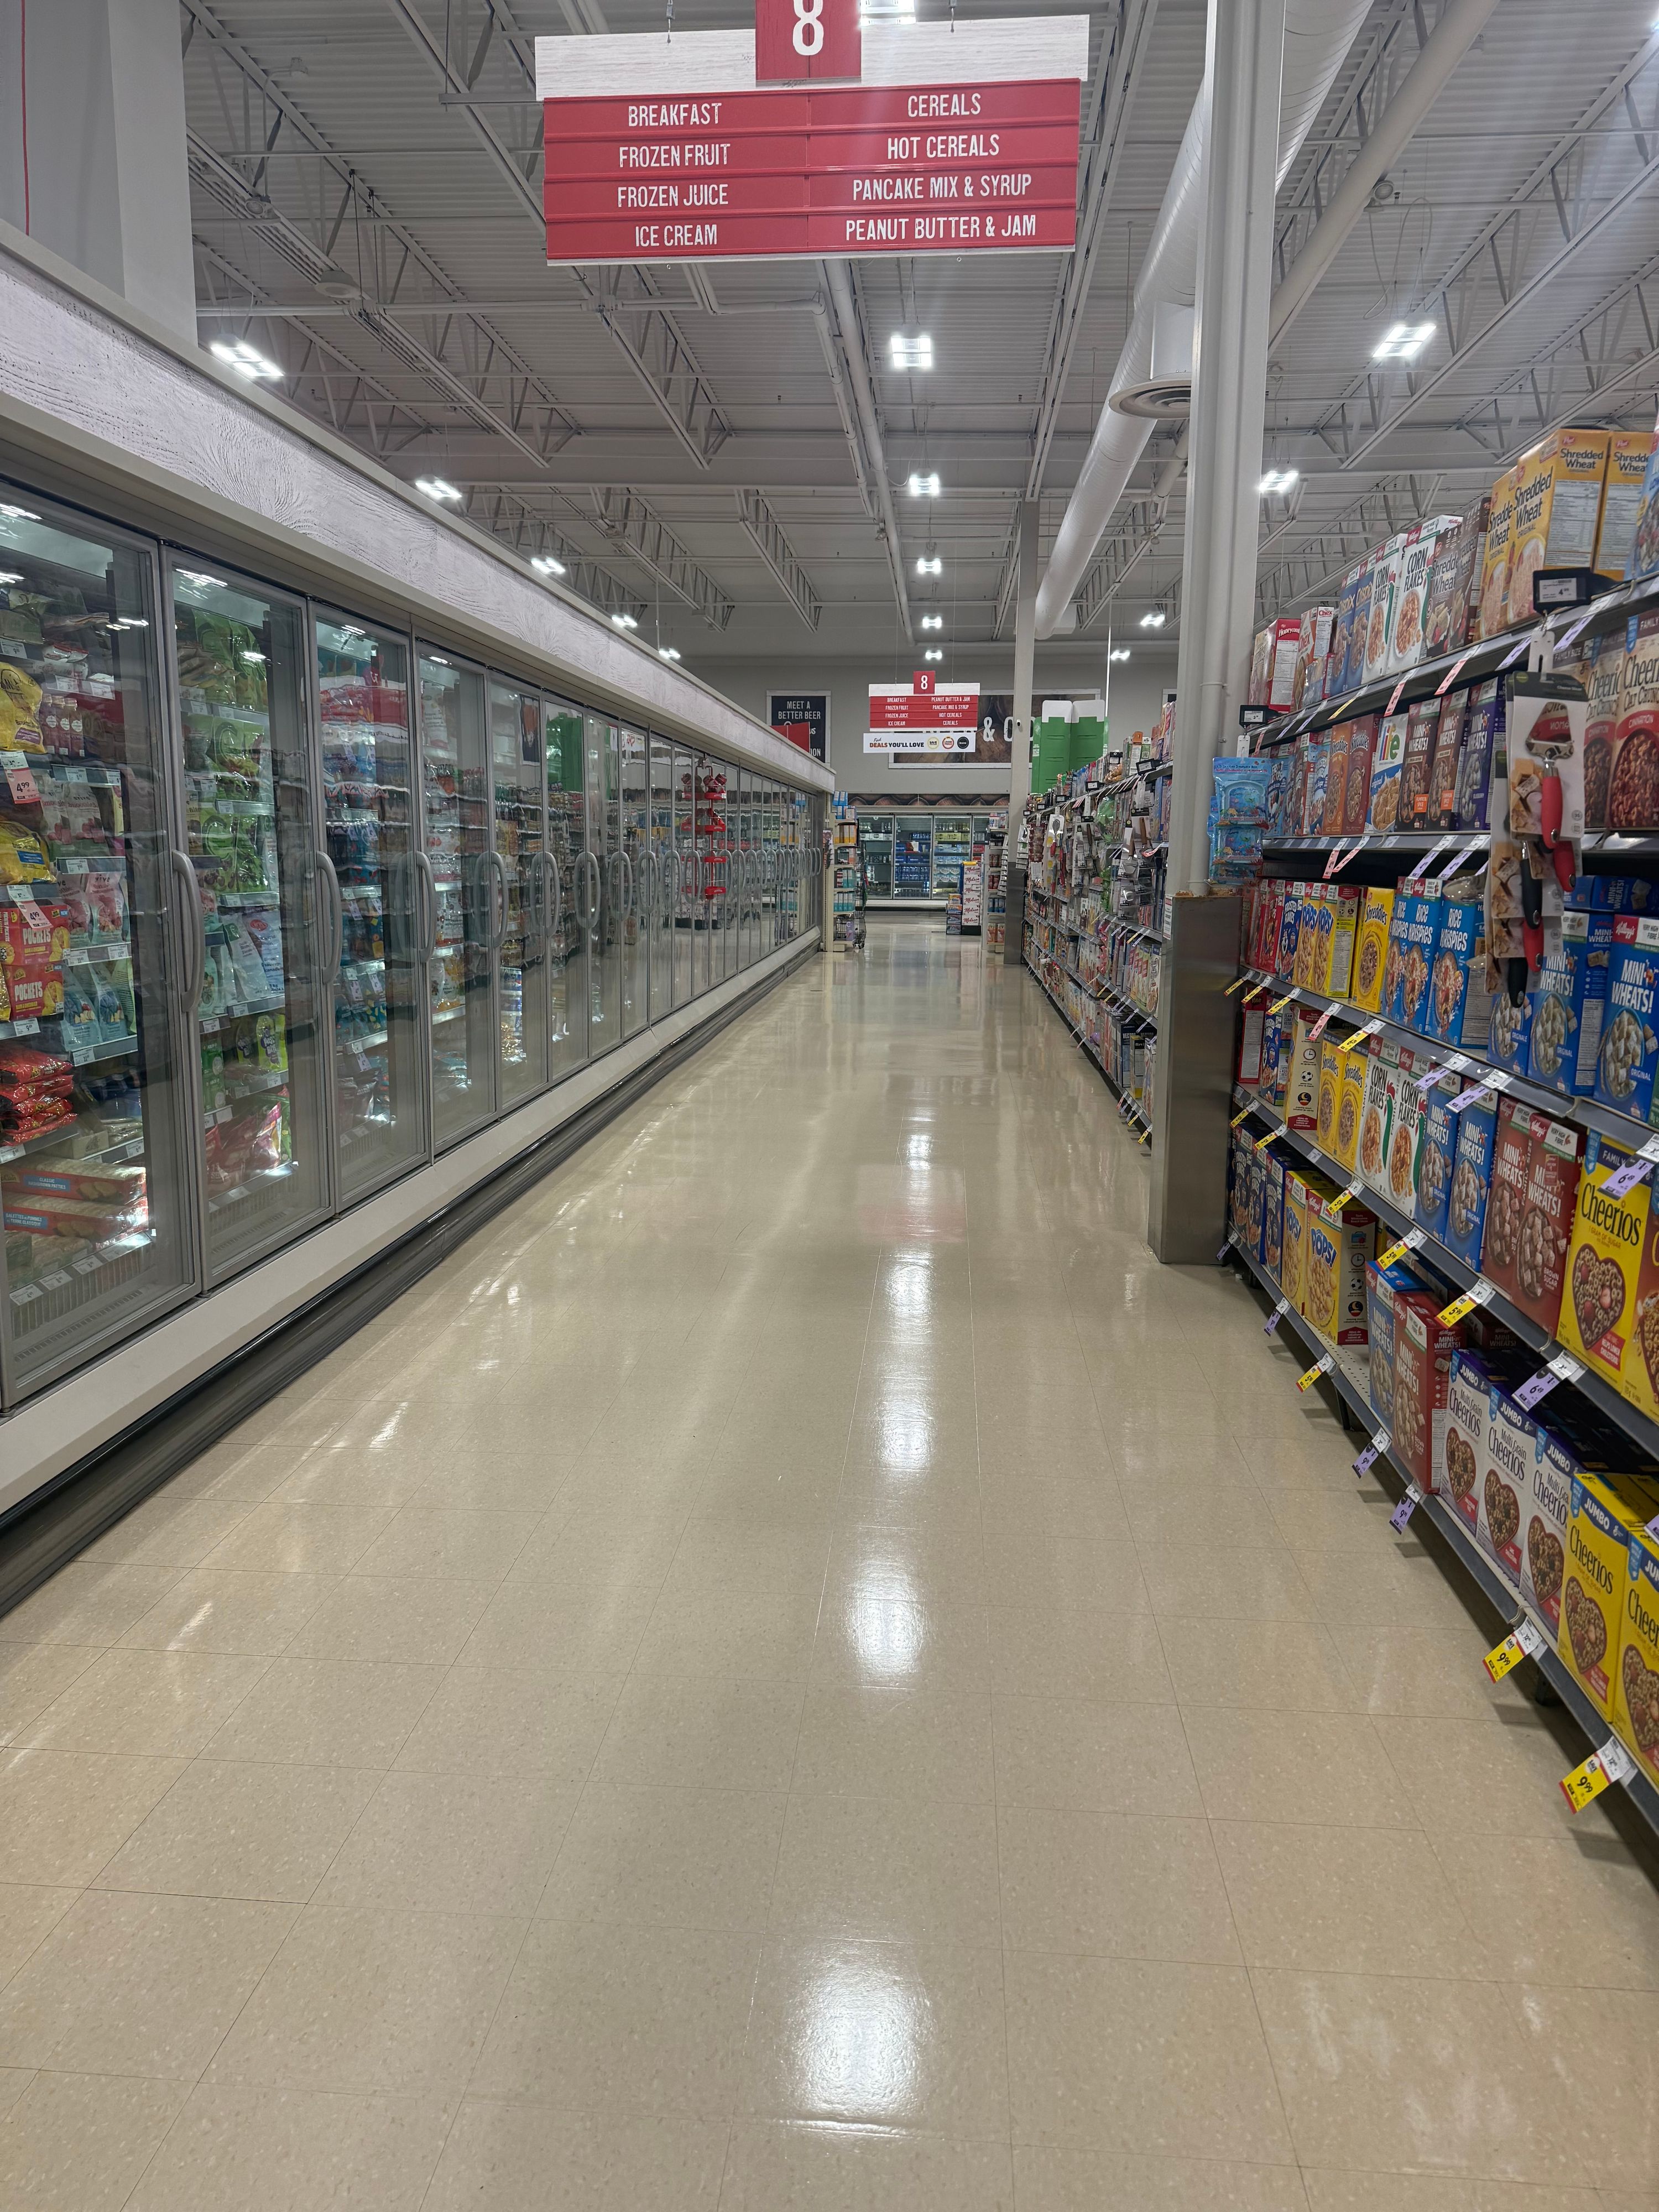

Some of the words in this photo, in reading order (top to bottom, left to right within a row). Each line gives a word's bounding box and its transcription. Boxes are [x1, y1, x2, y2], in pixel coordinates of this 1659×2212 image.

[792, 0, 824, 55] 8
[629, 103, 722, 127] BREAKFAST
[907, 93, 981, 117] CEREALS
[619, 146, 680, 168] FROZEN
[685, 144, 730, 166] FRUIT
[888, 137, 921, 159] HOT
[926, 134, 999, 158] CEREALS
[618, 186, 678, 207] FROZEN
[684, 184, 728, 206] JUICE
[853, 178, 924, 201] PANCAKE
[930, 176, 958, 198] MIX
[964, 176, 974, 196] &
[980, 174, 1032, 196] SYRUP
[635, 226, 659, 247] ICE
[664, 225, 717, 246] CREAM
[846, 218, 909, 241] PEANUT
[915, 216, 980, 239] BUTTER
[986, 216, 995, 237] &
[1001, 215, 1036, 236] JAM
[1560, 448, 1604, 460] Shredded
[1566, 458, 1597, 469] Wheat
[1619, 462, 1646, 472] Whea
[1514, 466, 1553, 511] Shredded
[1515, 497, 1542, 530] Wheat
[1489, 525, 1510, 552] Wheat
[1407, 546, 1428, 573] CORN
[1375, 563, 1390, 589] CORN
[1404, 567, 1426, 593] FLAKES
[921, 675, 928, 690] 8
[778, 711, 802, 719] BETTER
[805, 711, 821, 719] BEER
[983, 716, 995, 742] &
[1379, 723, 1400, 761] life
[1365, 902, 1388, 927] Shreddies
[1415, 904, 1430, 923] Rice
[1448, 908, 1463, 929] Rice
[23, 928, 51, 945] POCKETS
[1615, 921, 1635, 940] Kellogg's
[14, 981, 43, 1002] POCKETS
[1540, 970, 1574, 997] WHEATS!
[1611, 980, 1654, 1014] WHEATS!
[1322, 1053, 1339, 1077] Shreddies
[1344, 1062, 1363, 1088] Shreddies
[1371, 1064, 1388, 1092] CORN
[1631, 1068, 1651, 1081] ORIGINAL
[1368, 1085, 1385, 1110] FLAKES
[1401, 1079, 1419, 1109] CORN
[1397, 1102, 1416, 1129] FLAKES
[1427, 1118, 1449, 1145] WHEATS!
[1460, 1136, 1485, 1166] WHEATS!
[1603, 1151, 1626, 1167] FAMILY
[1497, 1157, 1525, 1189] WHEATS!
[1528, 1180, 1561, 1218] WHEATS!
[1581, 1182, 1642, 1246] Cheerios
[1396, 1354, 1420, 1395] WHEATS!
[1460, 1364, 1478, 1386] JUMBO
[1449, 1387, 1481, 1437] Cheerios
[1460, 1388, 1471, 1406] Multi
[1470, 1396, 1483, 1417] Grain
[1500, 1402, 1522, 1427] JUMBO
[1489, 1426, 1525, 1481] Cheerios
[1501, 1428, 1513, 1445] Multi
[1512, 1437, 1527, 1460] Grain
[1547, 1444, 1571, 1473] JUMBO
[1547, 1472, 1560, 1491] Multi
[1533, 1469, 1568, 1530] Cheerio
[1584, 1498, 1610, 1530] JUMBO
[1569, 1525, 1614, 1595] Cheerios
